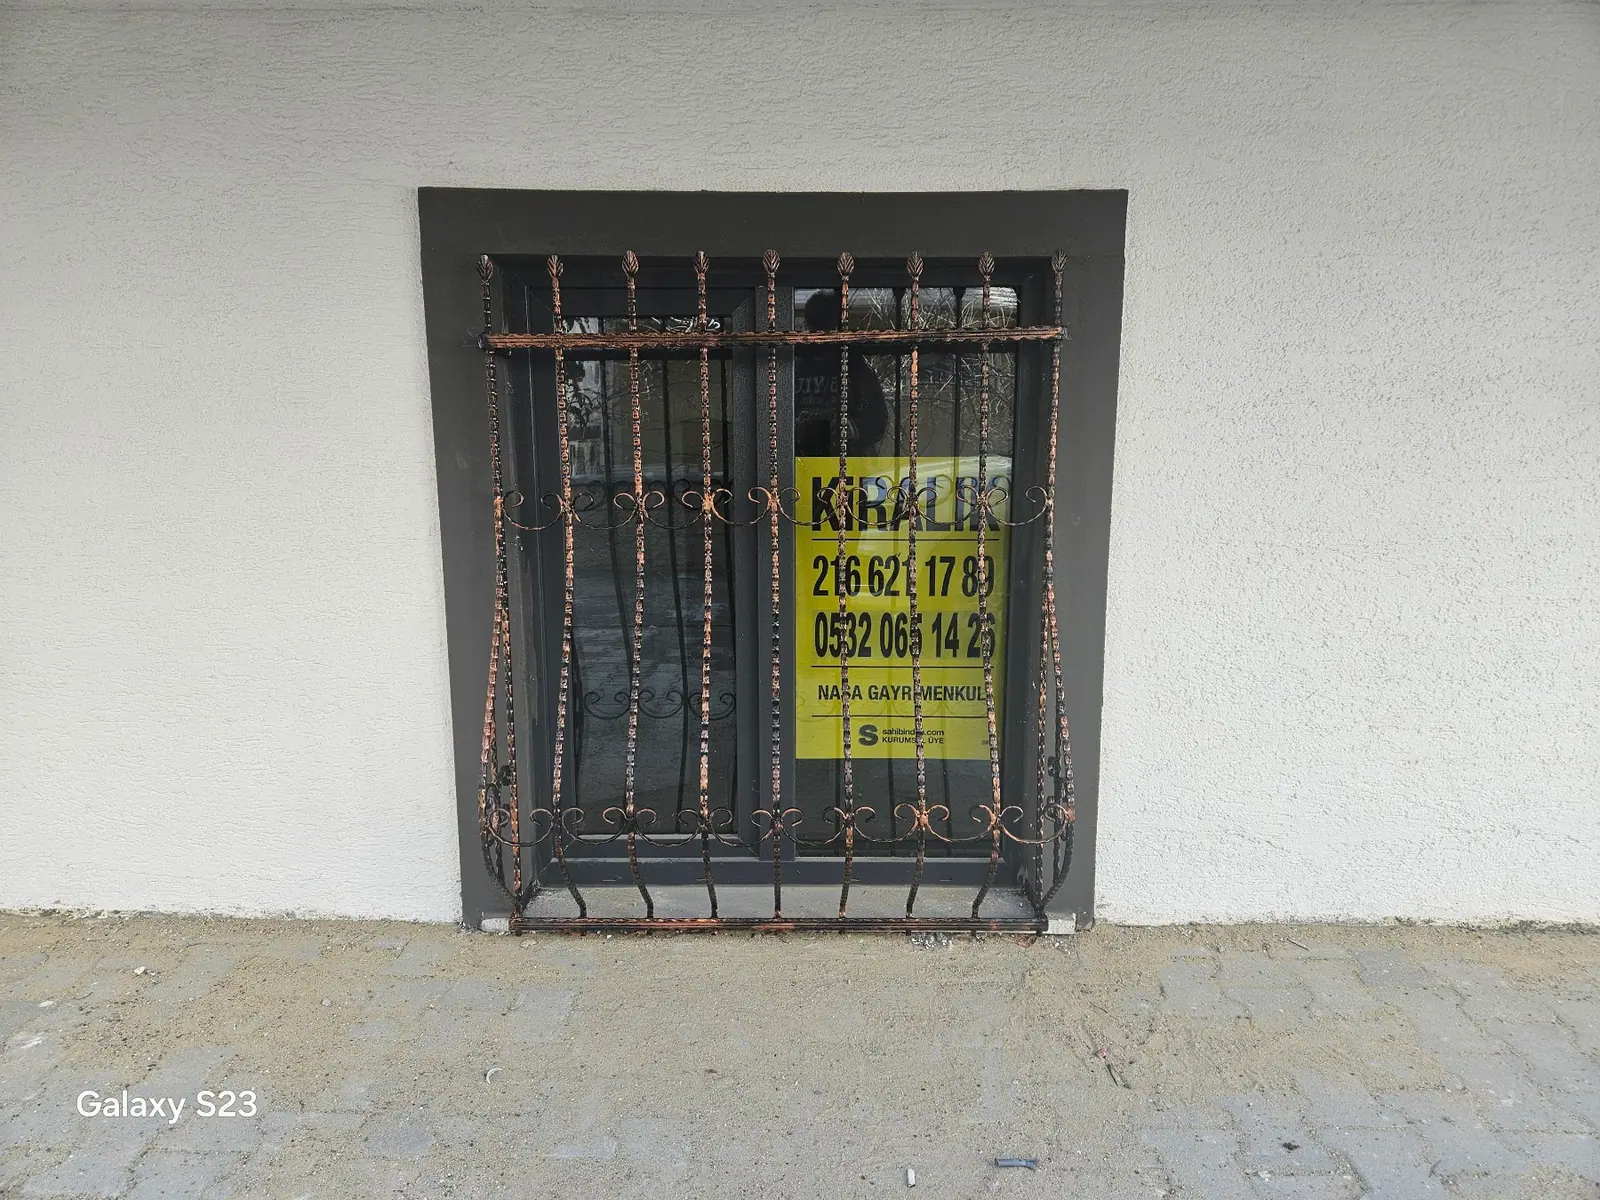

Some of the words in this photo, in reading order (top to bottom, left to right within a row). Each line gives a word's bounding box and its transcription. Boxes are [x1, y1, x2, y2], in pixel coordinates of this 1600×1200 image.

[812, 555, 861, 597] 216
[868, 555, 912, 597] 621
[925, 555, 956, 597] 17
[814, 611, 872, 658] 0532
[931, 612, 960, 658] 14
[868, 685, 986, 701] GAYRMENKUL
[858, 724, 879, 746] S
[881, 736, 926, 744] KURUMSL
[928, 735, 945, 745] ÜYE
[882, 728, 945, 737] sahibind.com
